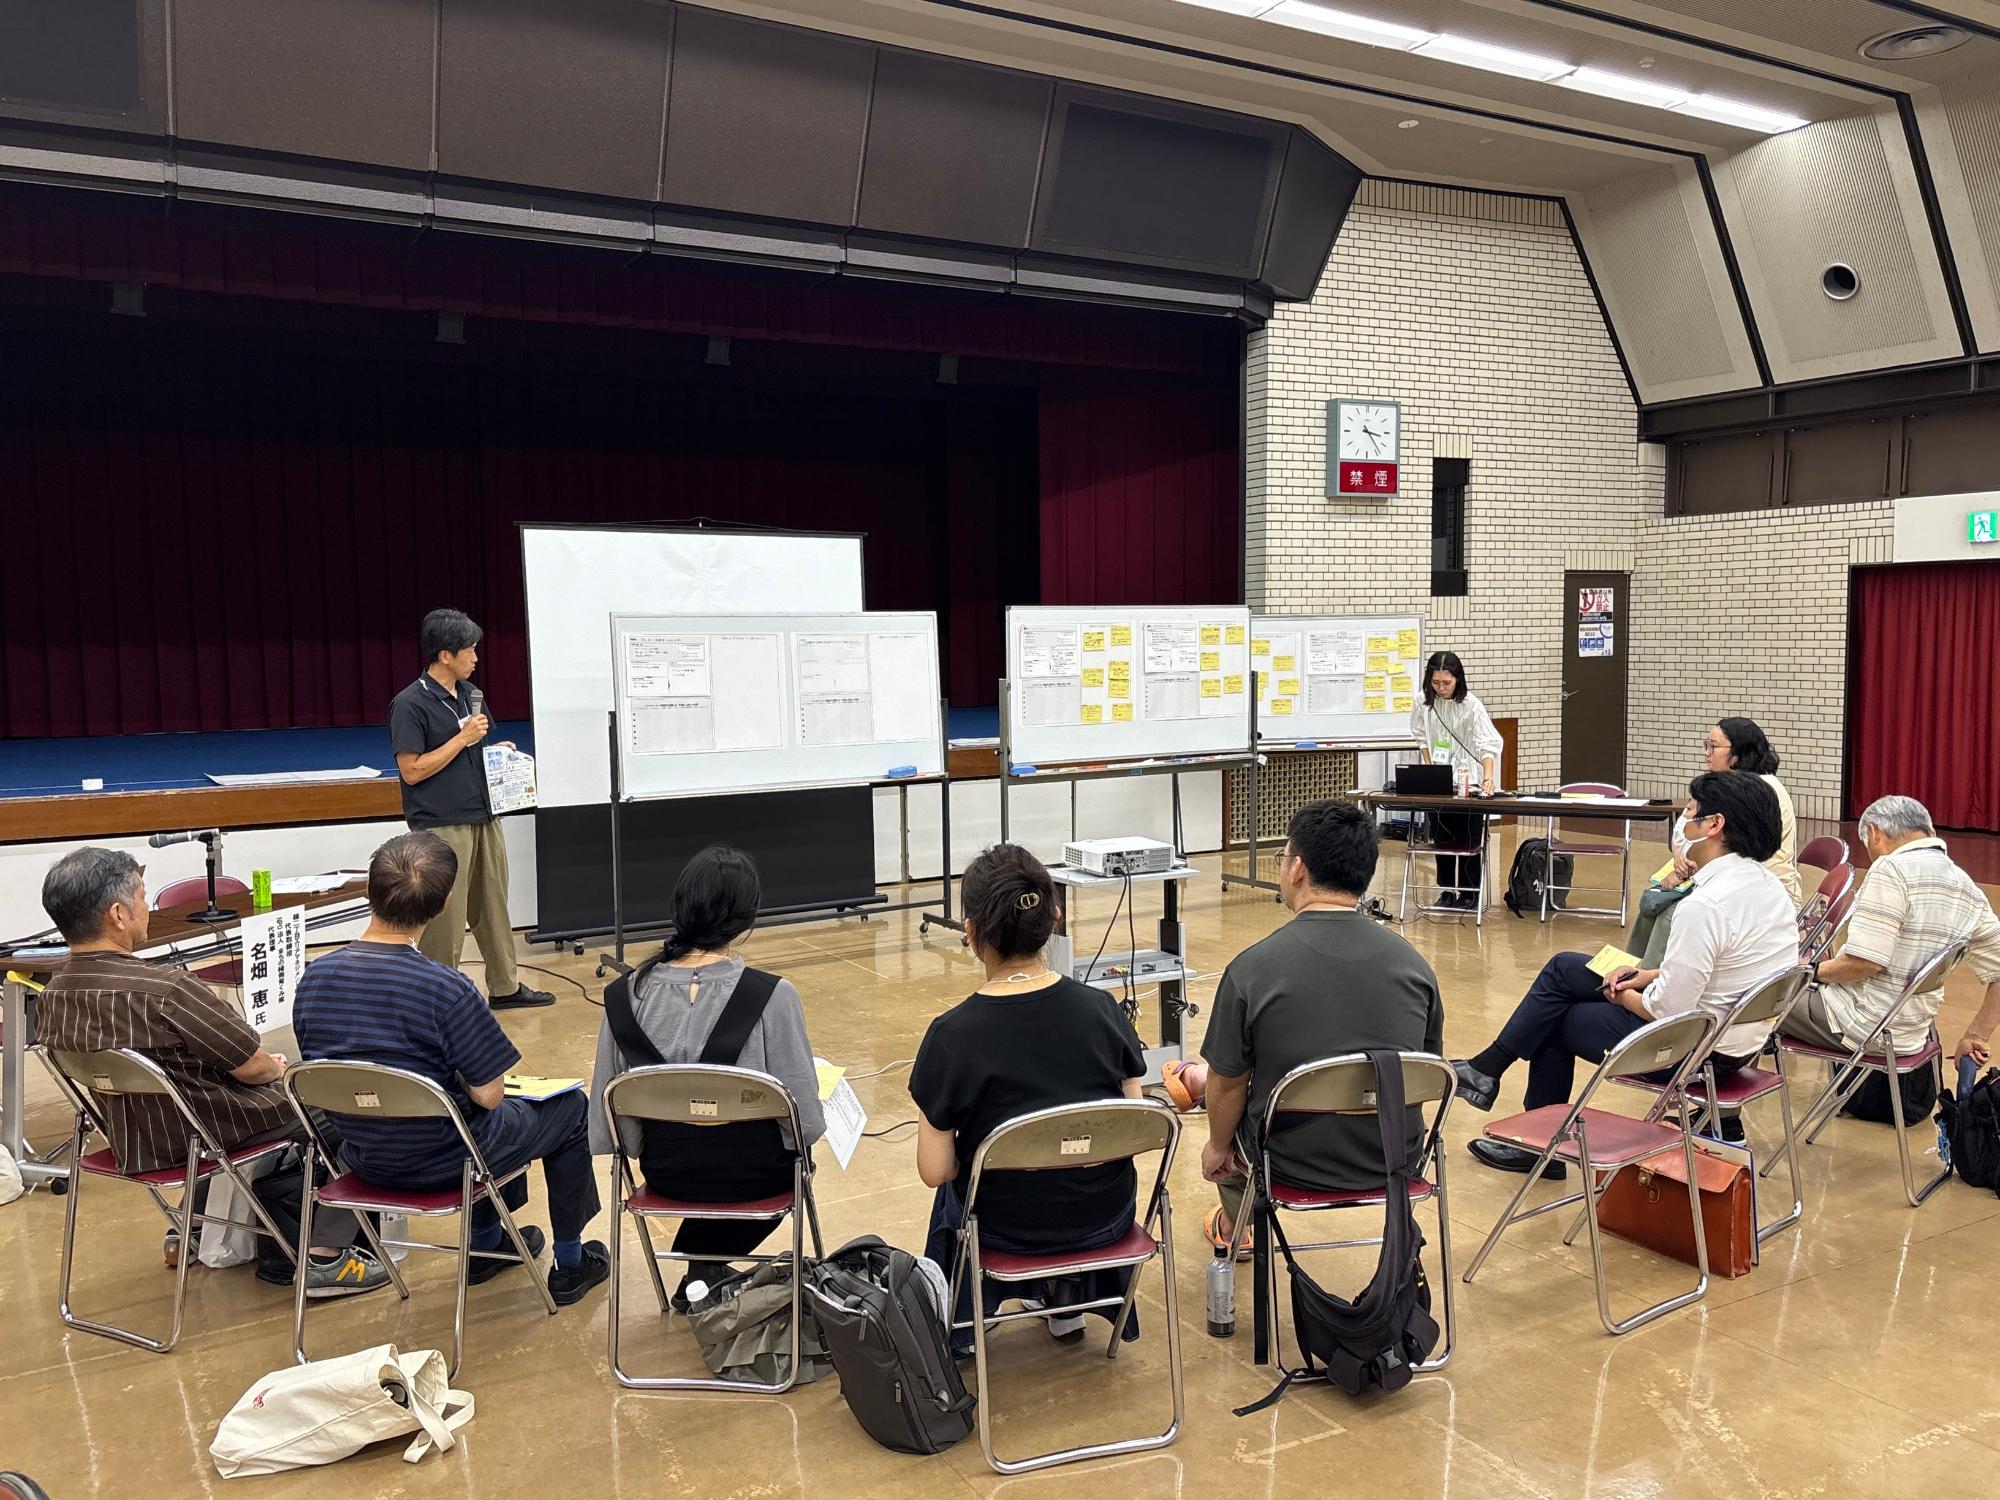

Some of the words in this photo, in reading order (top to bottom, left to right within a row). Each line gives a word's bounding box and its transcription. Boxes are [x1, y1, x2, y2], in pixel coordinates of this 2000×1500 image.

[1349, 469, 1388, 487] 禁煙
[251, 942, 268, 981] 名畑
[251, 988, 269, 1009] 恵
[255, 1011, 267, 1026] 氏
[336, 1258, 364, 1281] M
